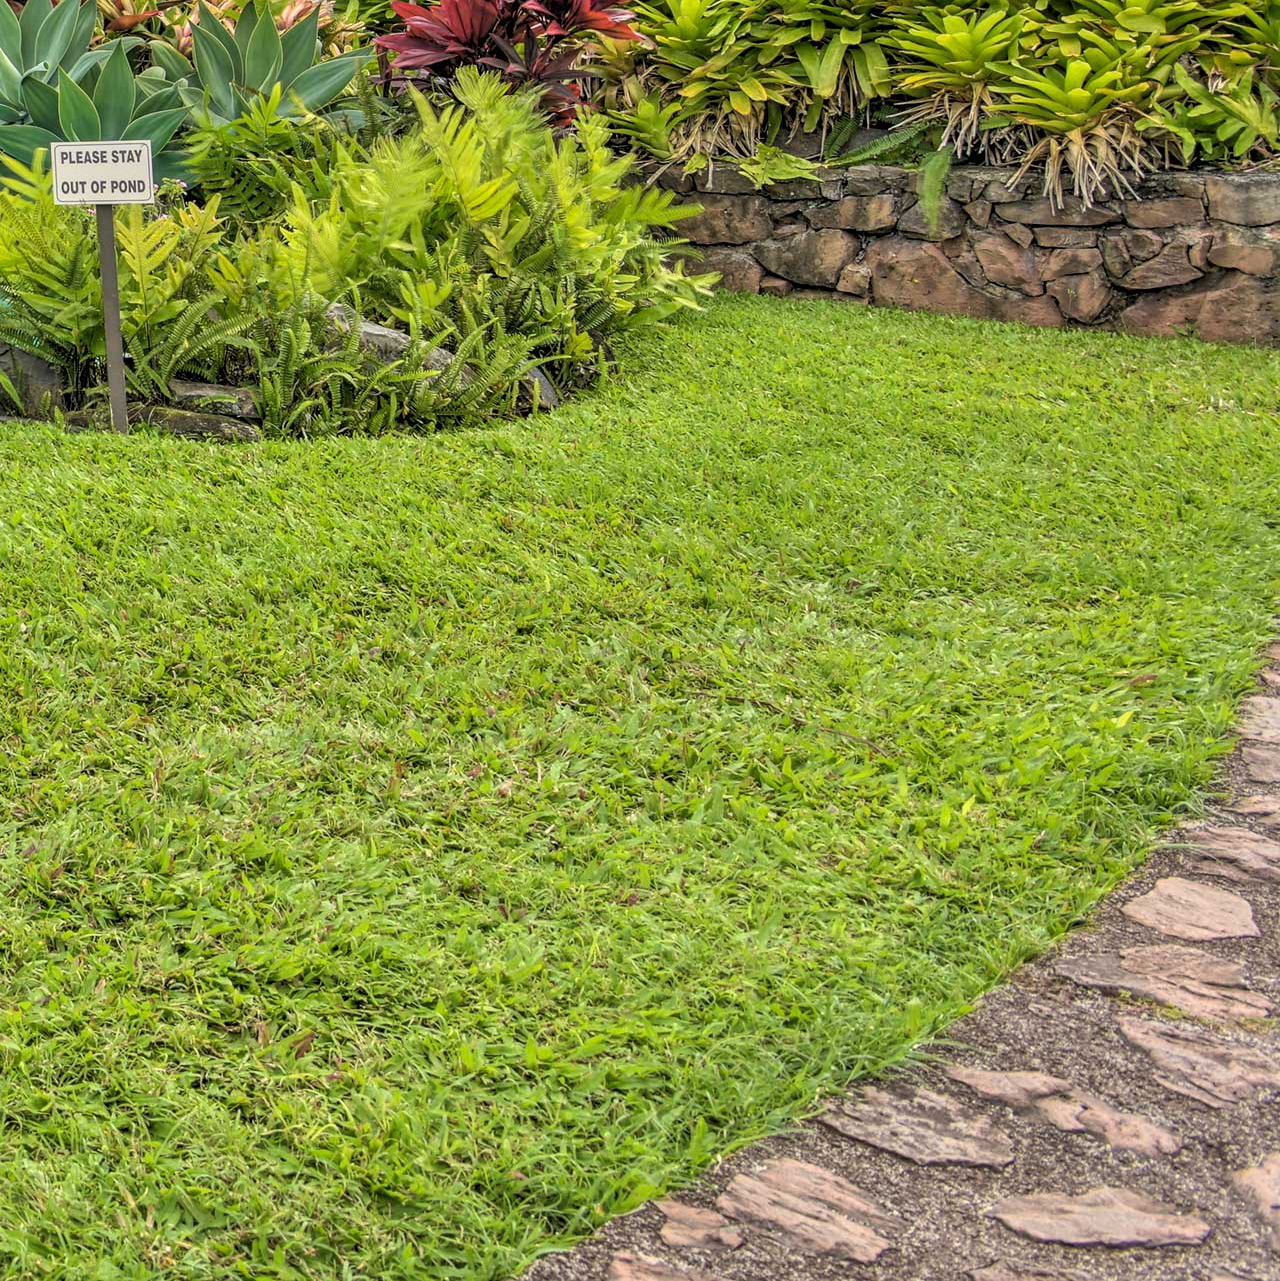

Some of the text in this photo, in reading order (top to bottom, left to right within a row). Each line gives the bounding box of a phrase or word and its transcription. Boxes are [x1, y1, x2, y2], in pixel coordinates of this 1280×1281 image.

[60, 149, 142, 164] PLEASE STAY
[61, 180, 146, 194] OUT OF POND
